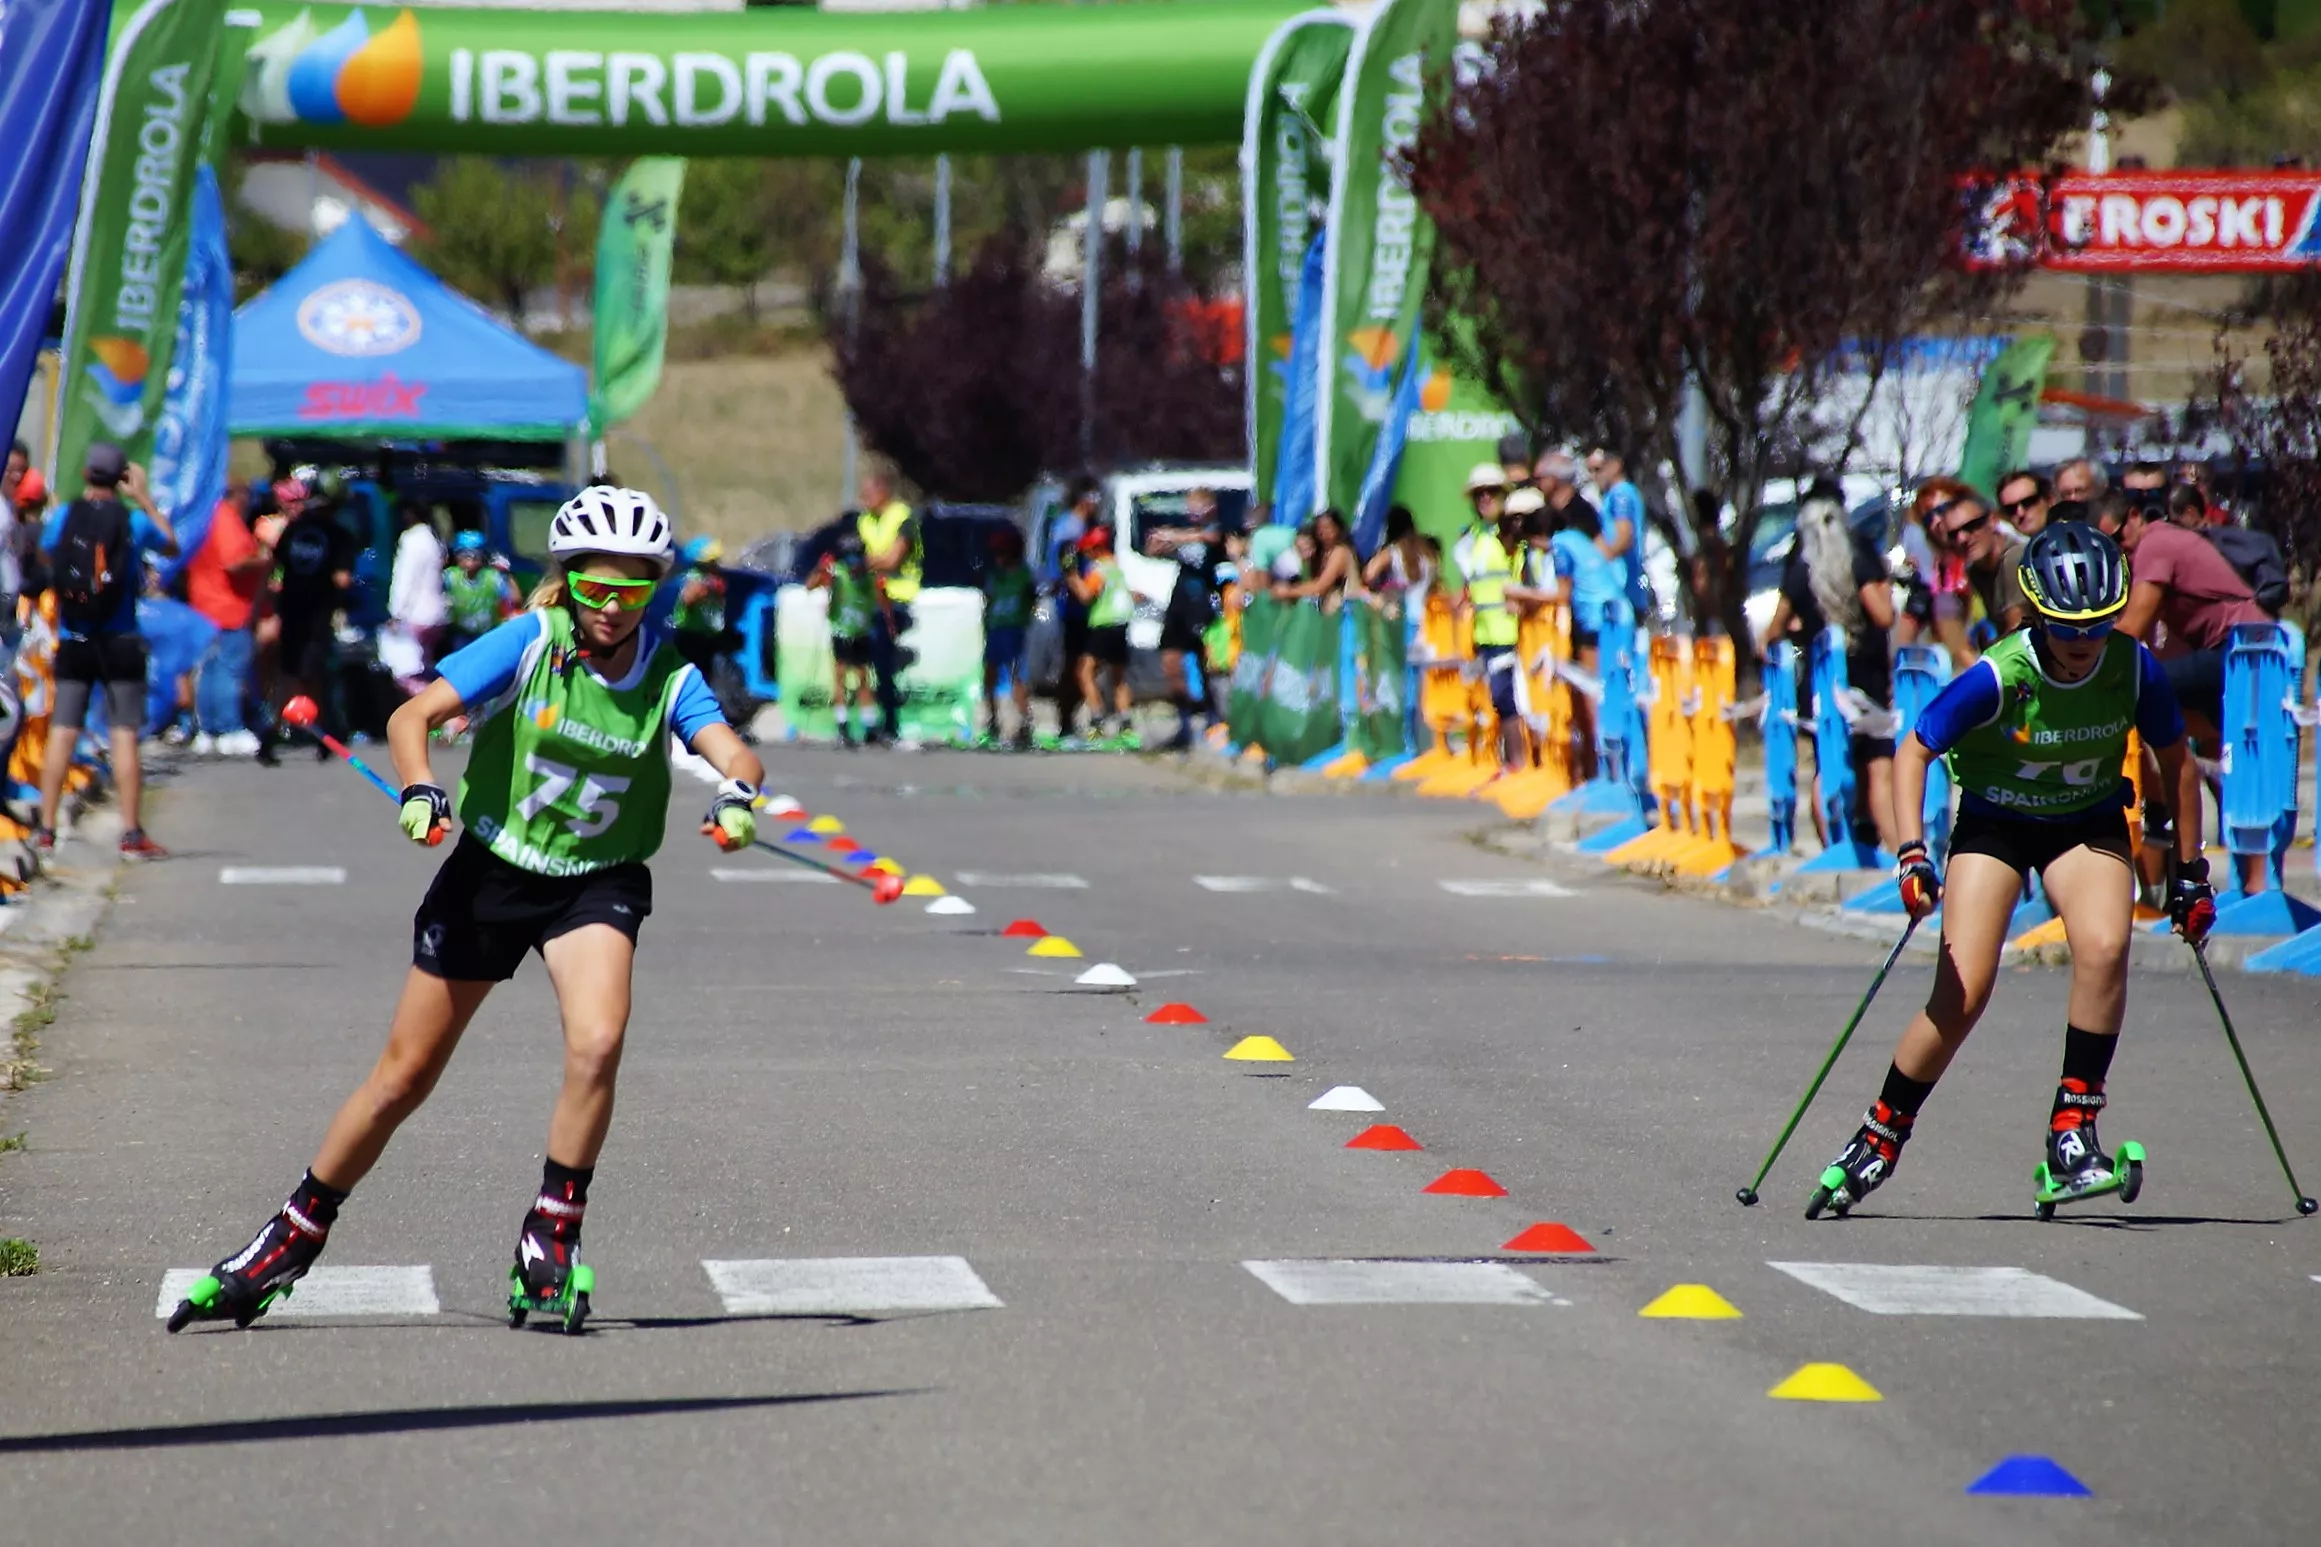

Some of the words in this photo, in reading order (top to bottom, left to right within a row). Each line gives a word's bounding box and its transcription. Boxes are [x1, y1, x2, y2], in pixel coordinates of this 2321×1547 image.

[449, 47, 1001, 127] IBERDROLA
[116, 61, 191, 331] IBERDROLA
[1368, 52, 1425, 320] IBERDOLA
[2034, 715, 2128, 745] IBERDROLA
[515, 751, 633, 839] 75
